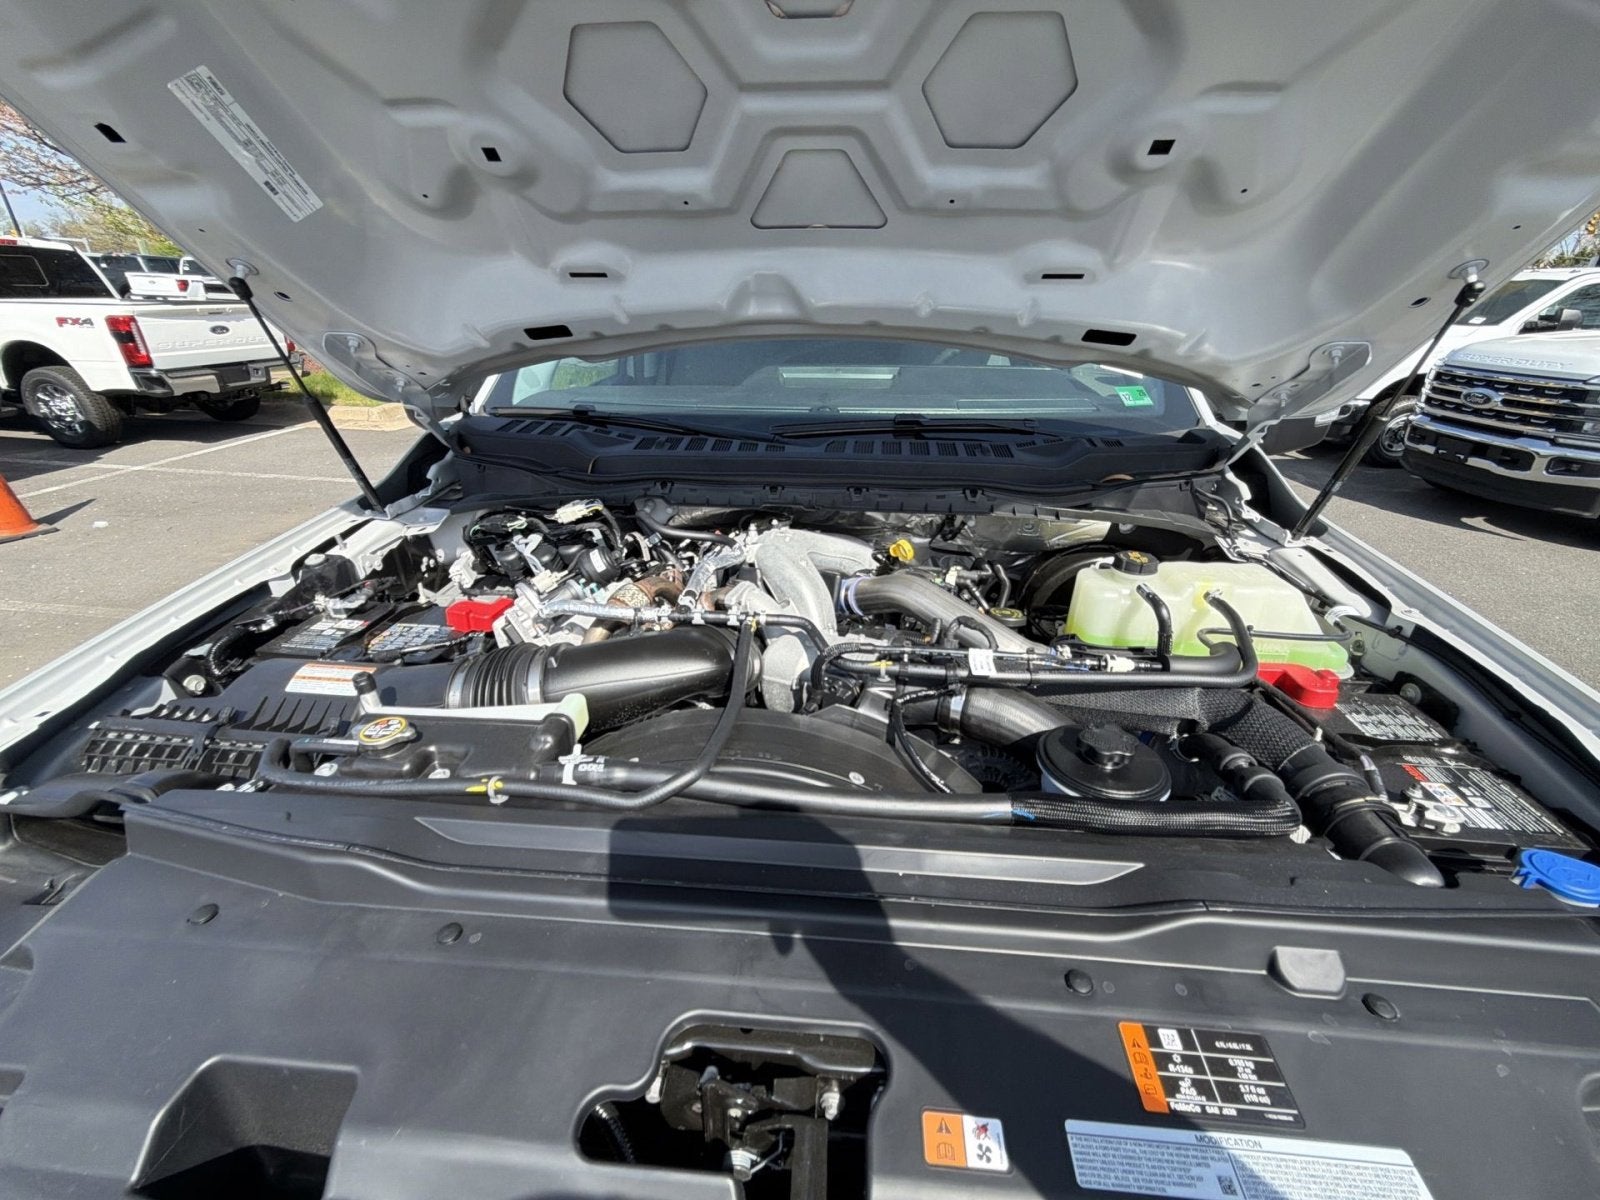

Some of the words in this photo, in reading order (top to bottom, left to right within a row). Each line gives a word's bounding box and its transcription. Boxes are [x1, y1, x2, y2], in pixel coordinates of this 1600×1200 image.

[56, 317, 94, 328] FX4
[1515, 358, 1574, 369] DUTY
[1170, 1102, 1202, 1112] FoMoCo
[1194, 1134, 1262, 1149] MODIFICATION
